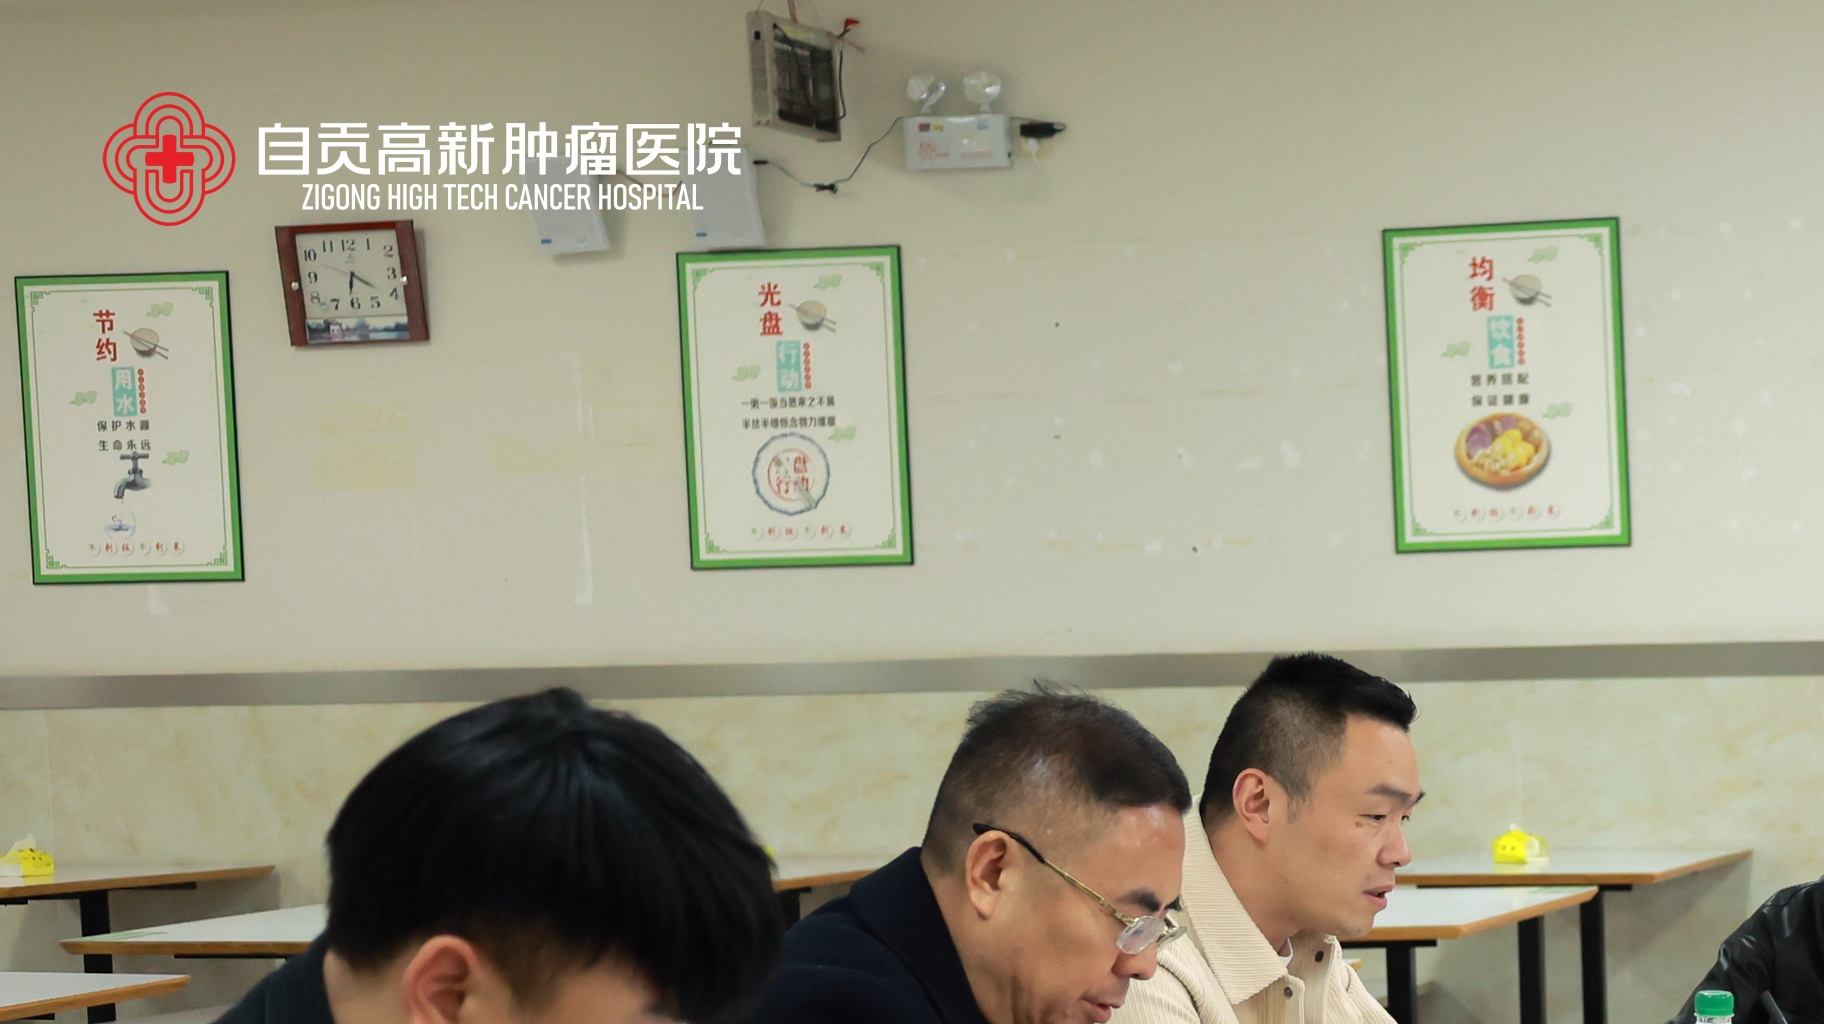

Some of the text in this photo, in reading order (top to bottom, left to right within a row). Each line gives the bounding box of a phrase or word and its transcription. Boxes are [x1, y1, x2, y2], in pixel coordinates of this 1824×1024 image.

[322, 240, 334, 253] 11
[341, 239, 356, 252] 12
[383, 245, 394, 258] 2
[303, 249, 317, 262] 10
[308, 271, 318, 284] 9
[386, 267, 397, 280] 3
[1469, 256, 1495, 312] 均衡
[330, 298, 340, 311] 7
[350, 297, 361, 310] 6
[370, 296, 381, 309] 5
[758, 282, 783, 336] 光盘
[93, 309, 118, 362] 节约
[115, 369, 136, 415] 用水
[97, 420, 150, 432] 保护水源
[98, 439, 151, 451] 生命永远
